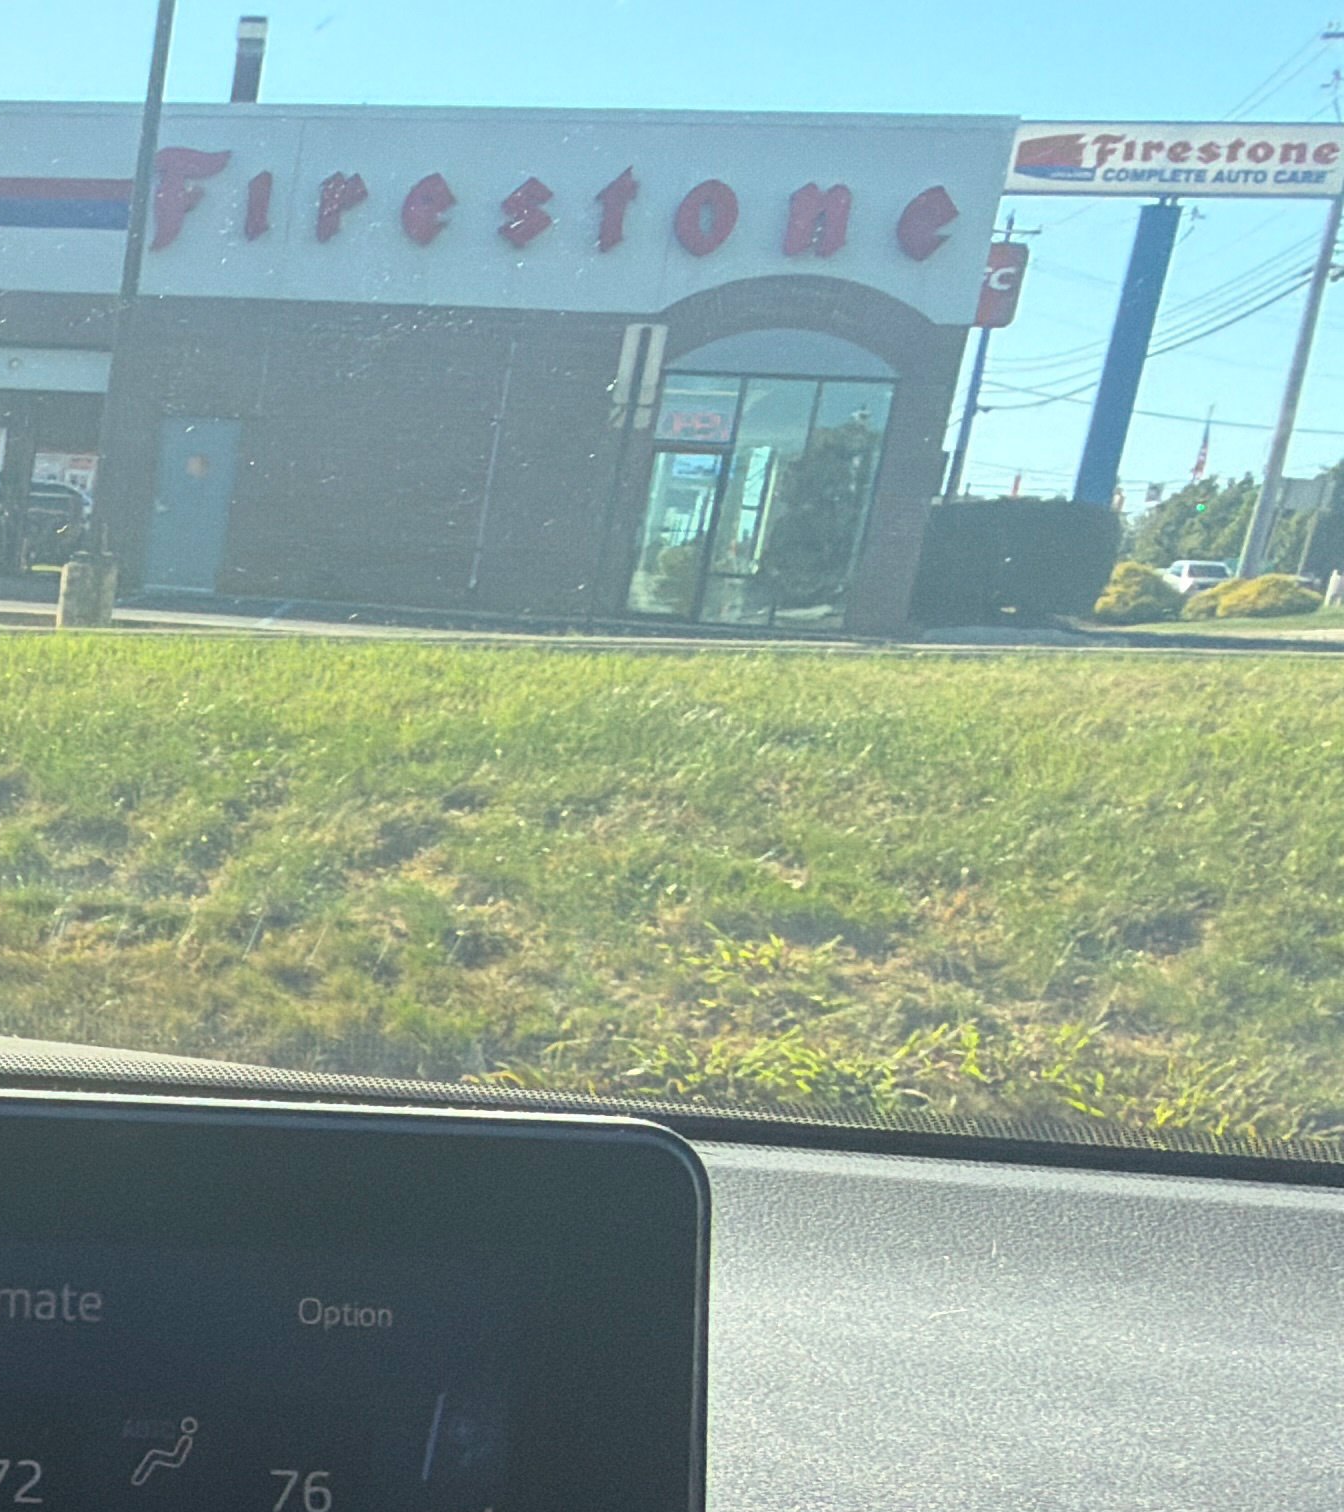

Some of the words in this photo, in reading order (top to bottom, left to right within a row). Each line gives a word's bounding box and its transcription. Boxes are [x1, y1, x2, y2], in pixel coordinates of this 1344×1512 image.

[1091, 132, 1340, 169] Firestone
[1101, 168, 1207, 184] COMPLETE
[1211, 168, 1268, 185] AUTO
[1272, 169, 1328, 186] CARE
[149, 146, 960, 264] Firestone
[297, 1297, 394, 1332] Option
